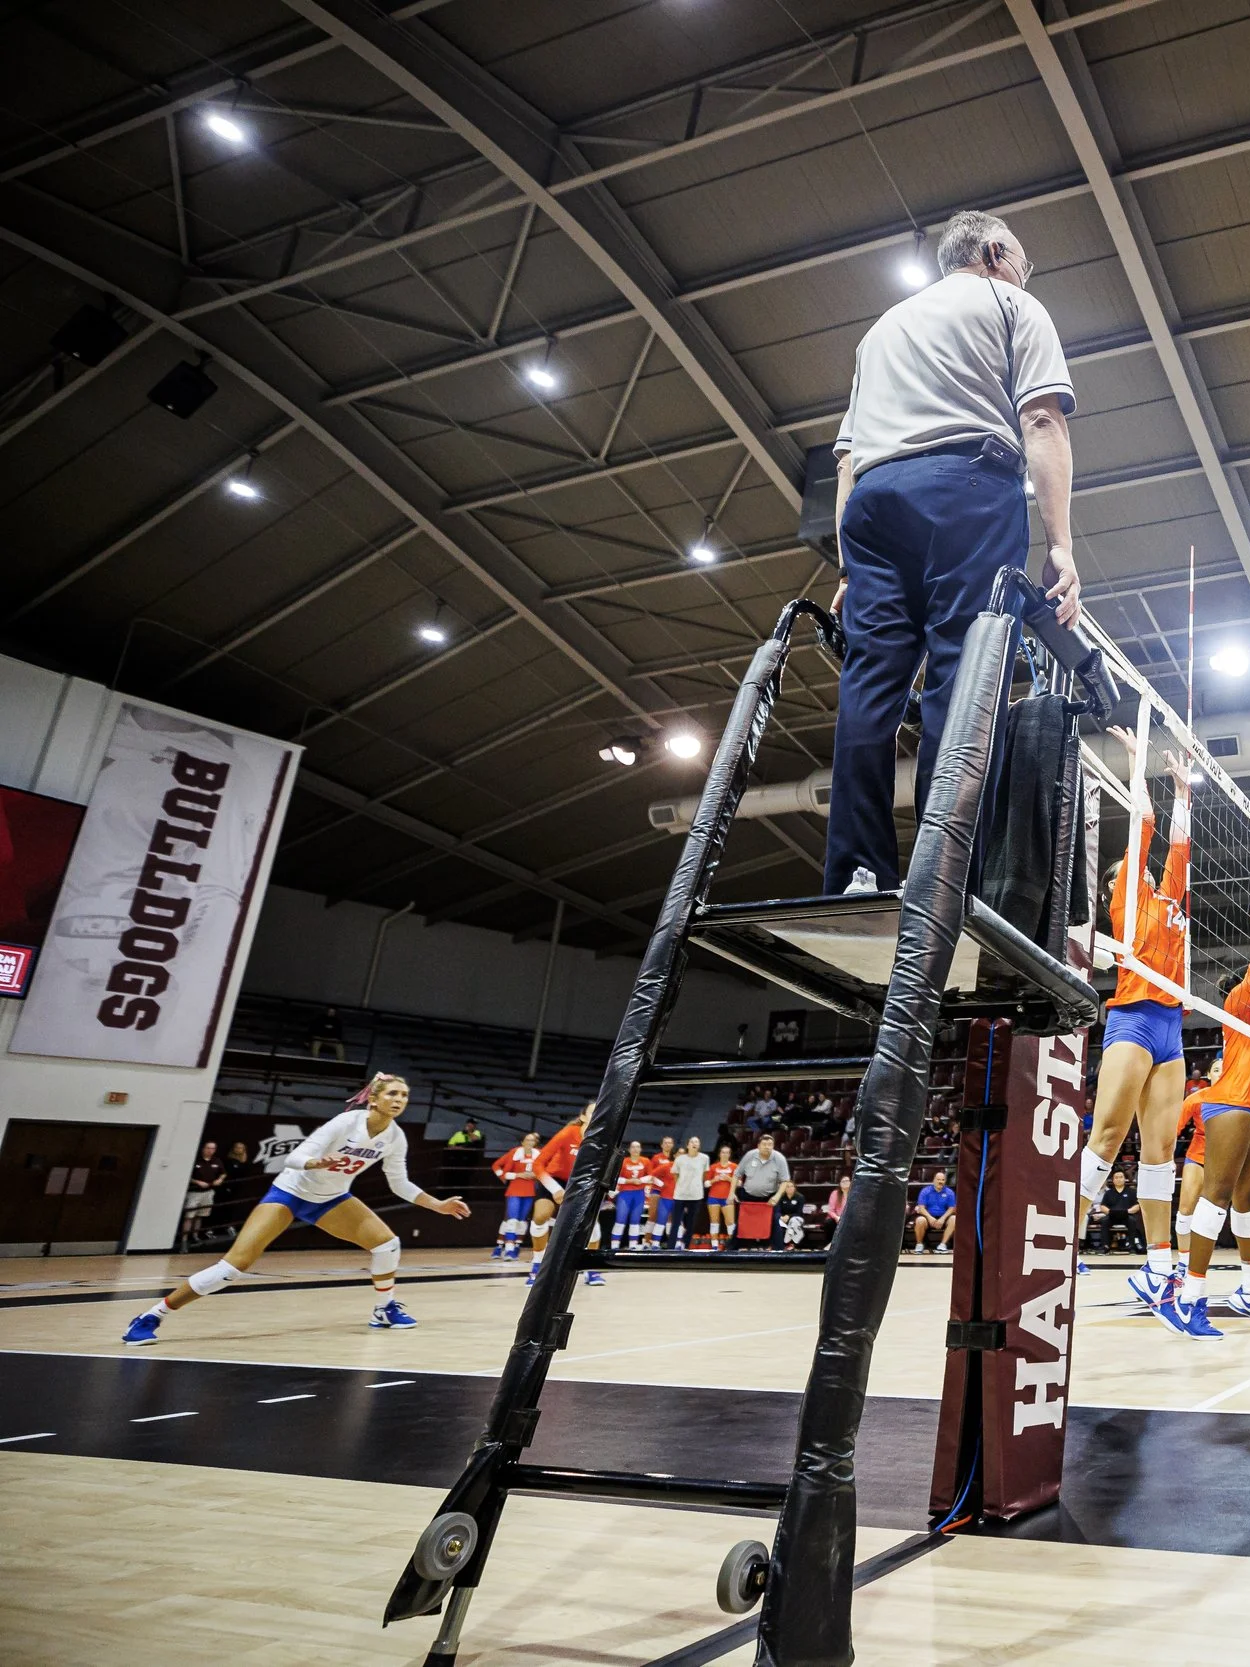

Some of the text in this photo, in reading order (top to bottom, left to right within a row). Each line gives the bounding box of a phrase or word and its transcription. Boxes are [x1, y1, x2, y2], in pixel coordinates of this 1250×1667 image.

[97, 750, 230, 1031] BULLDOGS
[1166, 903, 1187, 931] 14
[327, 1156, 365, 1175] 23
[1013, 1180, 1076, 1437] HAIL
